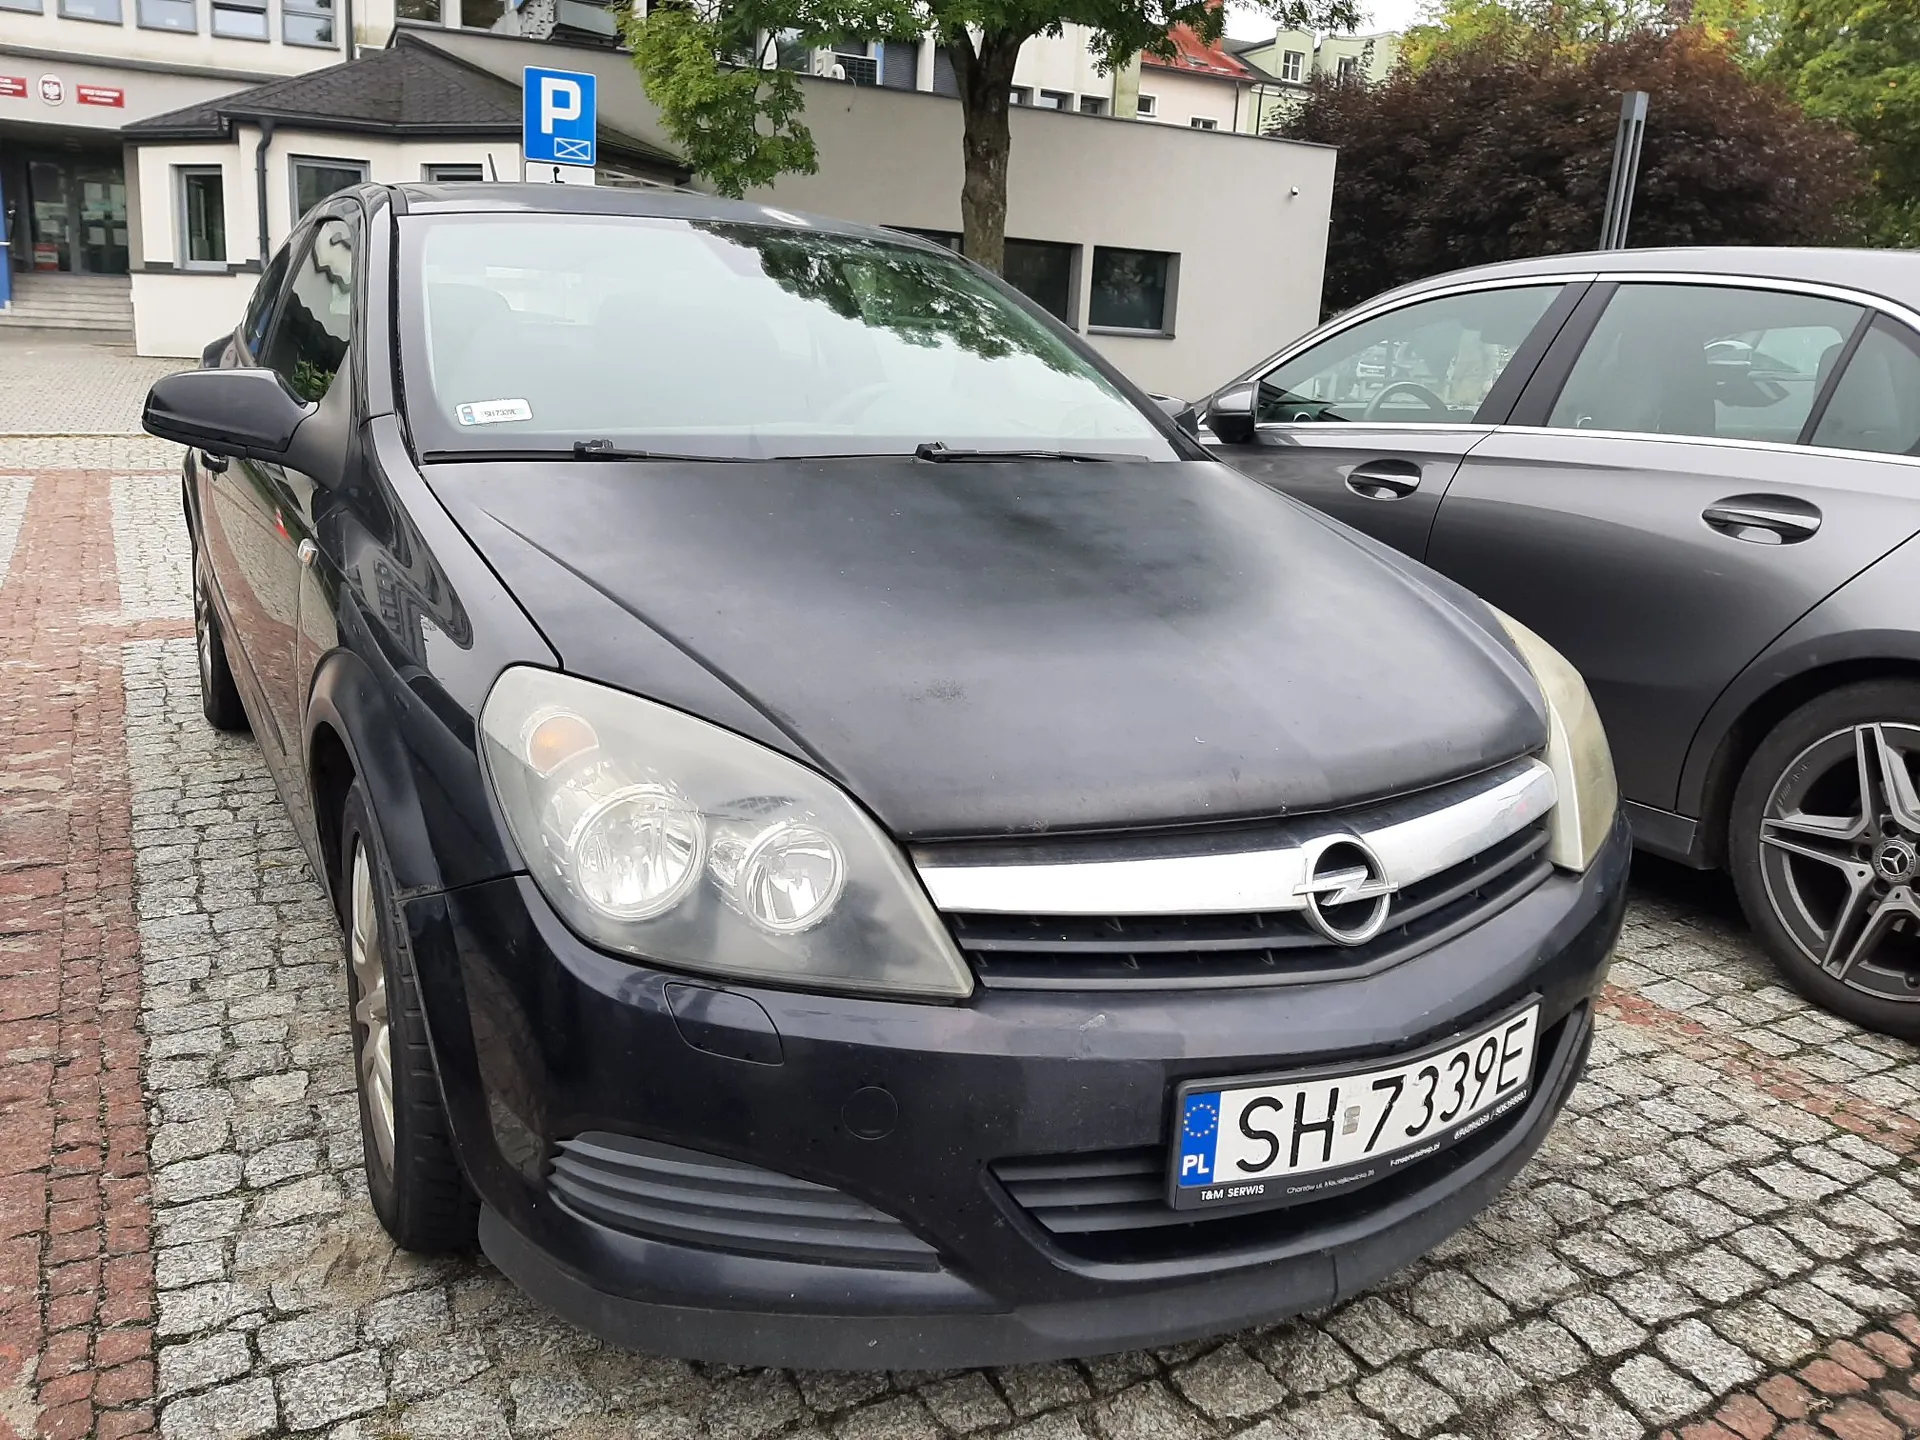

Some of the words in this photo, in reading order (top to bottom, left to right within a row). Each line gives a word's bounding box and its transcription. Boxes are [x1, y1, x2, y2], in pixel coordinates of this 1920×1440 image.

[541, 76, 581, 135] P
[1235, 1087, 1339, 1173] SH
[1363, 1016, 1529, 1153] 7339E
[1182, 1153, 1210, 1176] PL
[1201, 1189, 1224, 1201] T&M
[1227, 1184, 1265, 1198] SERWIS
